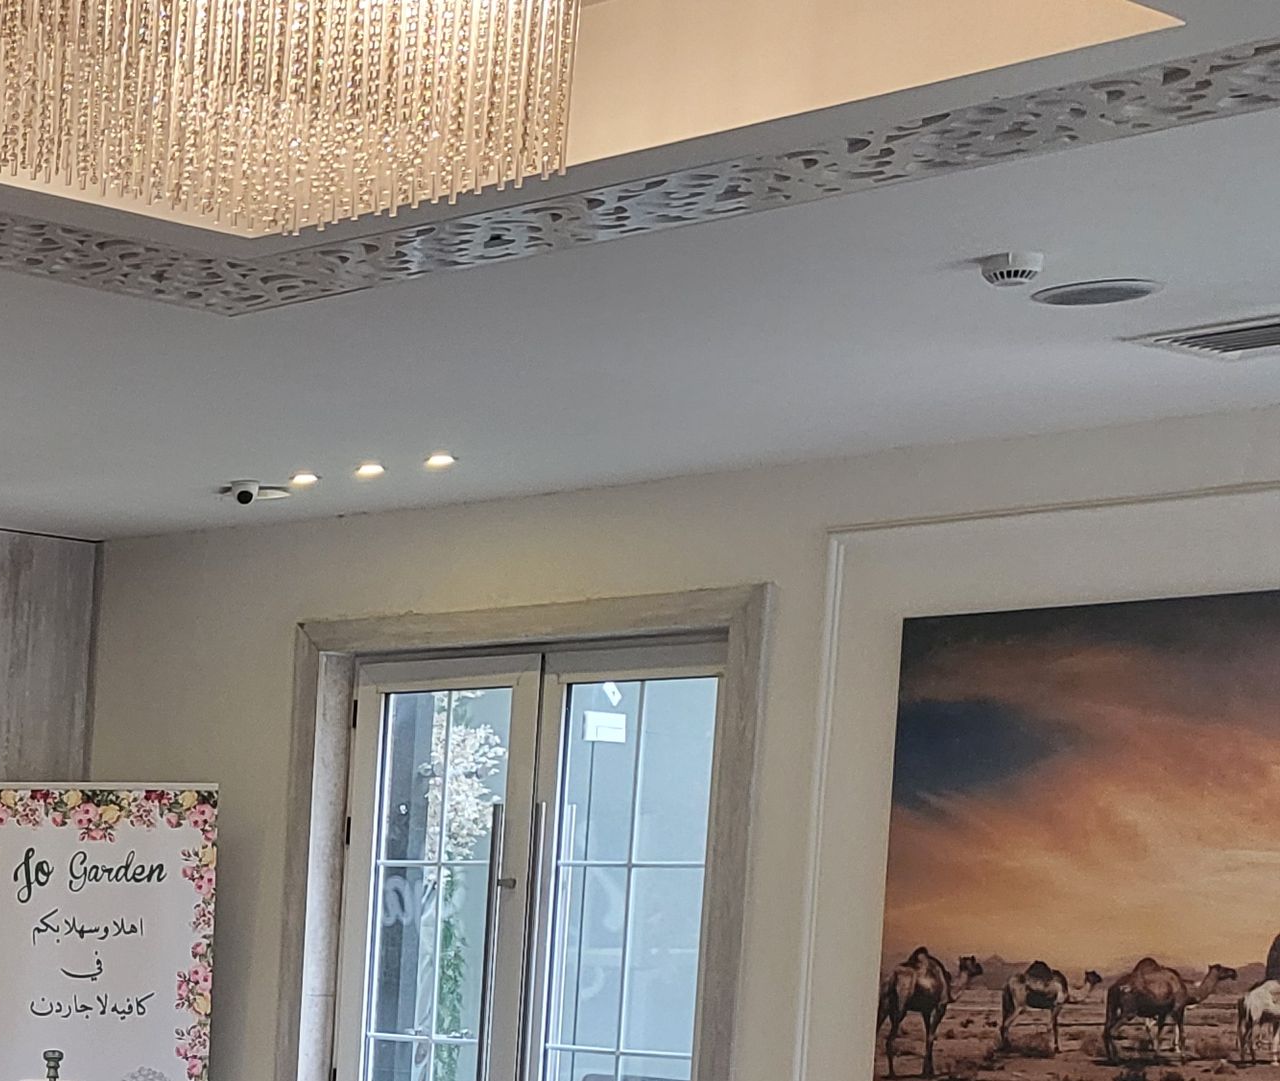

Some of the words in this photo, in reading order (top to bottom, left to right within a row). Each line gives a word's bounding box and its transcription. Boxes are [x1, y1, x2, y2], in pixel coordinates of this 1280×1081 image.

[13, 847, 55, 904] Jo
[68, 850, 168, 893] Garden
[112, 917, 144, 937] اهلا
[60, 951, 104, 982] في
[110, 992, 155, 1020] كافيه
